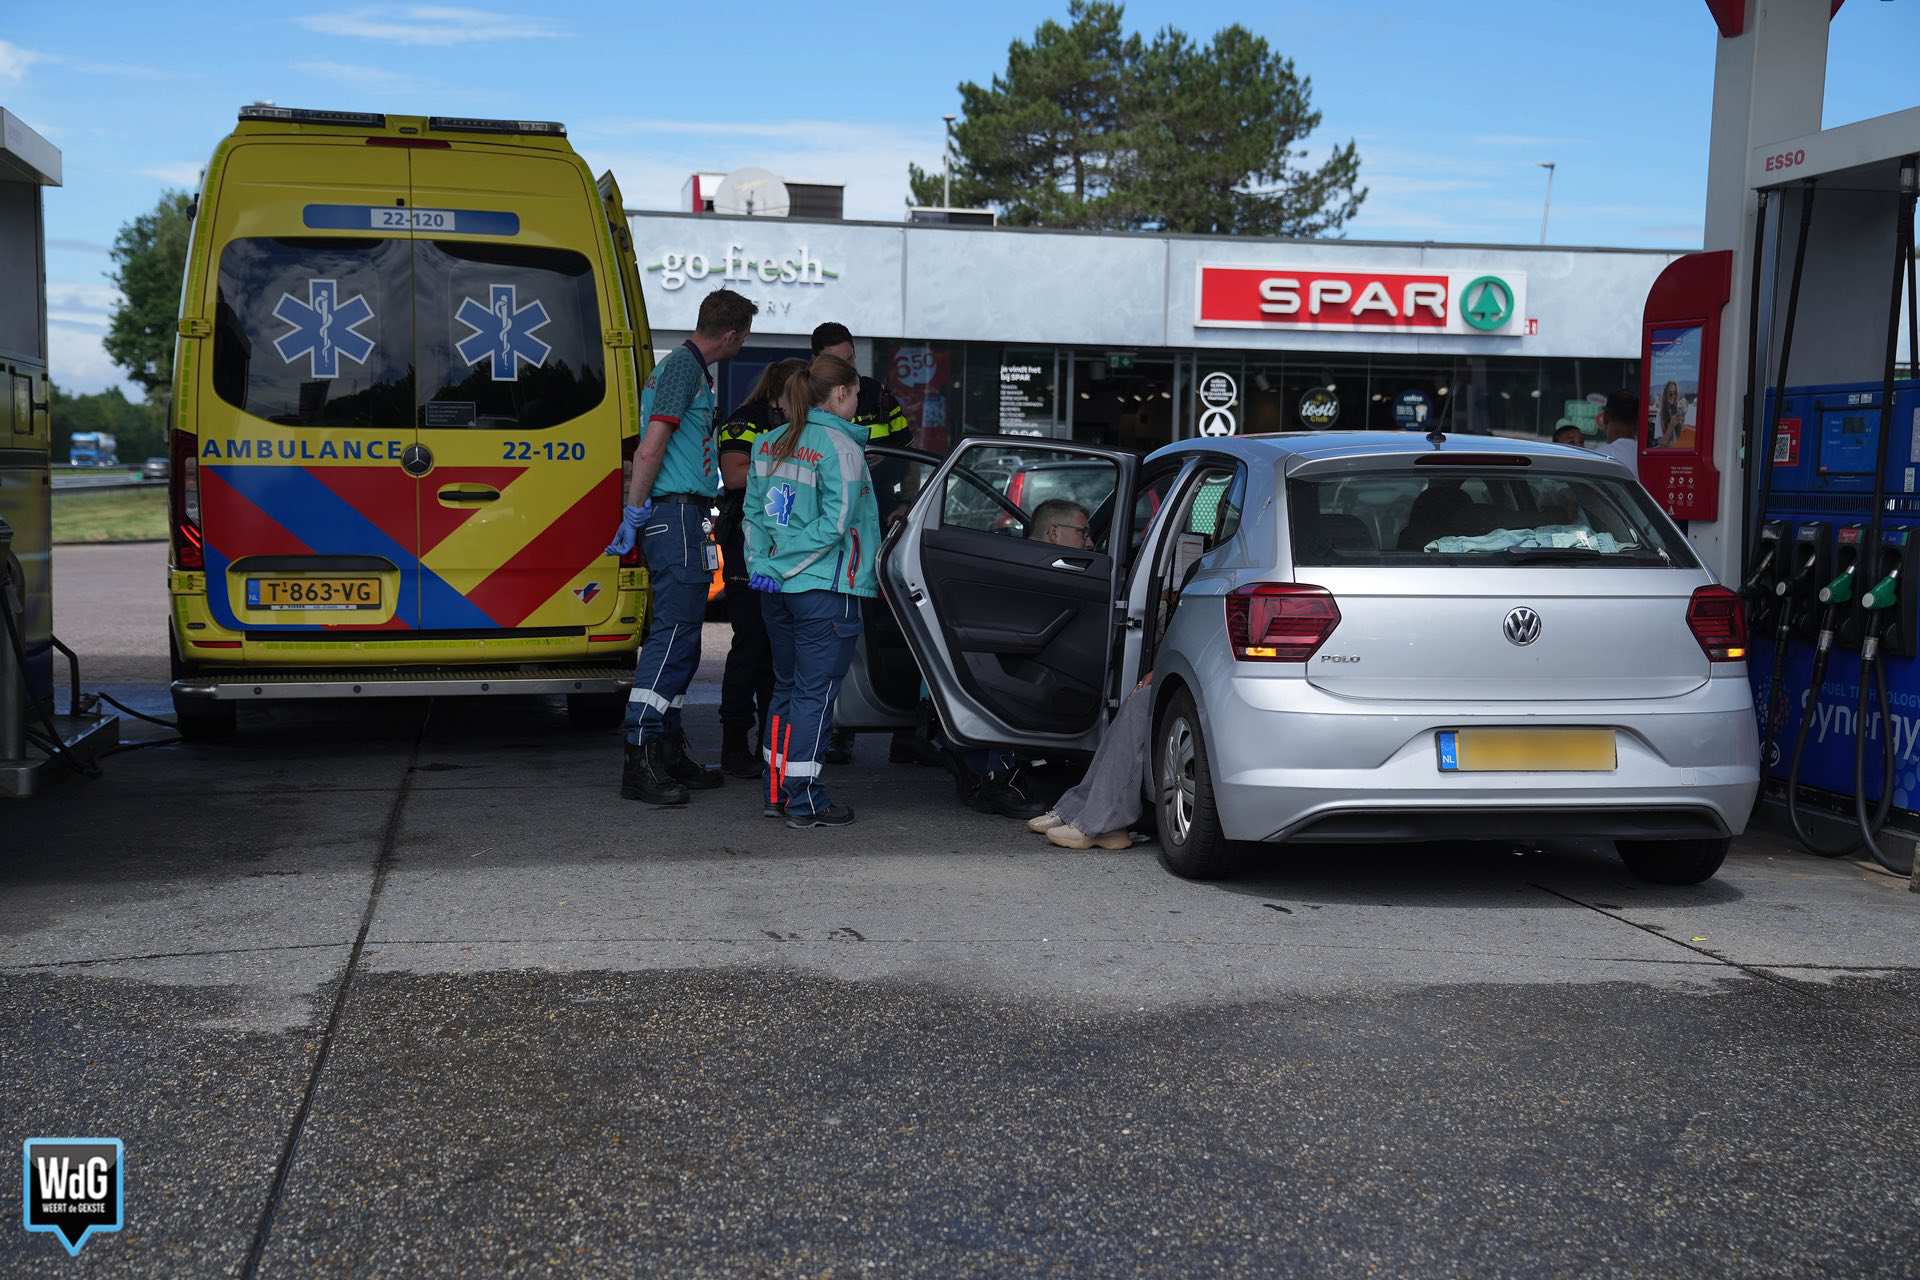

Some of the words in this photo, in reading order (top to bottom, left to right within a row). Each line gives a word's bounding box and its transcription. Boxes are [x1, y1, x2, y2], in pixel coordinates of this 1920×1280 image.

[1765, 149, 1806, 172] ESSO
[383, 211, 444, 228] 22-120
[661, 252, 710, 291] go
[723, 243, 825, 285] fresh
[1259, 278, 1447, 318] SPAR
[201, 439, 401, 461] AMBULANCE
[503, 441, 585, 461] 22-120
[1321, 655, 1361, 664] POLO
[1442, 754, 1455, 764] NL
